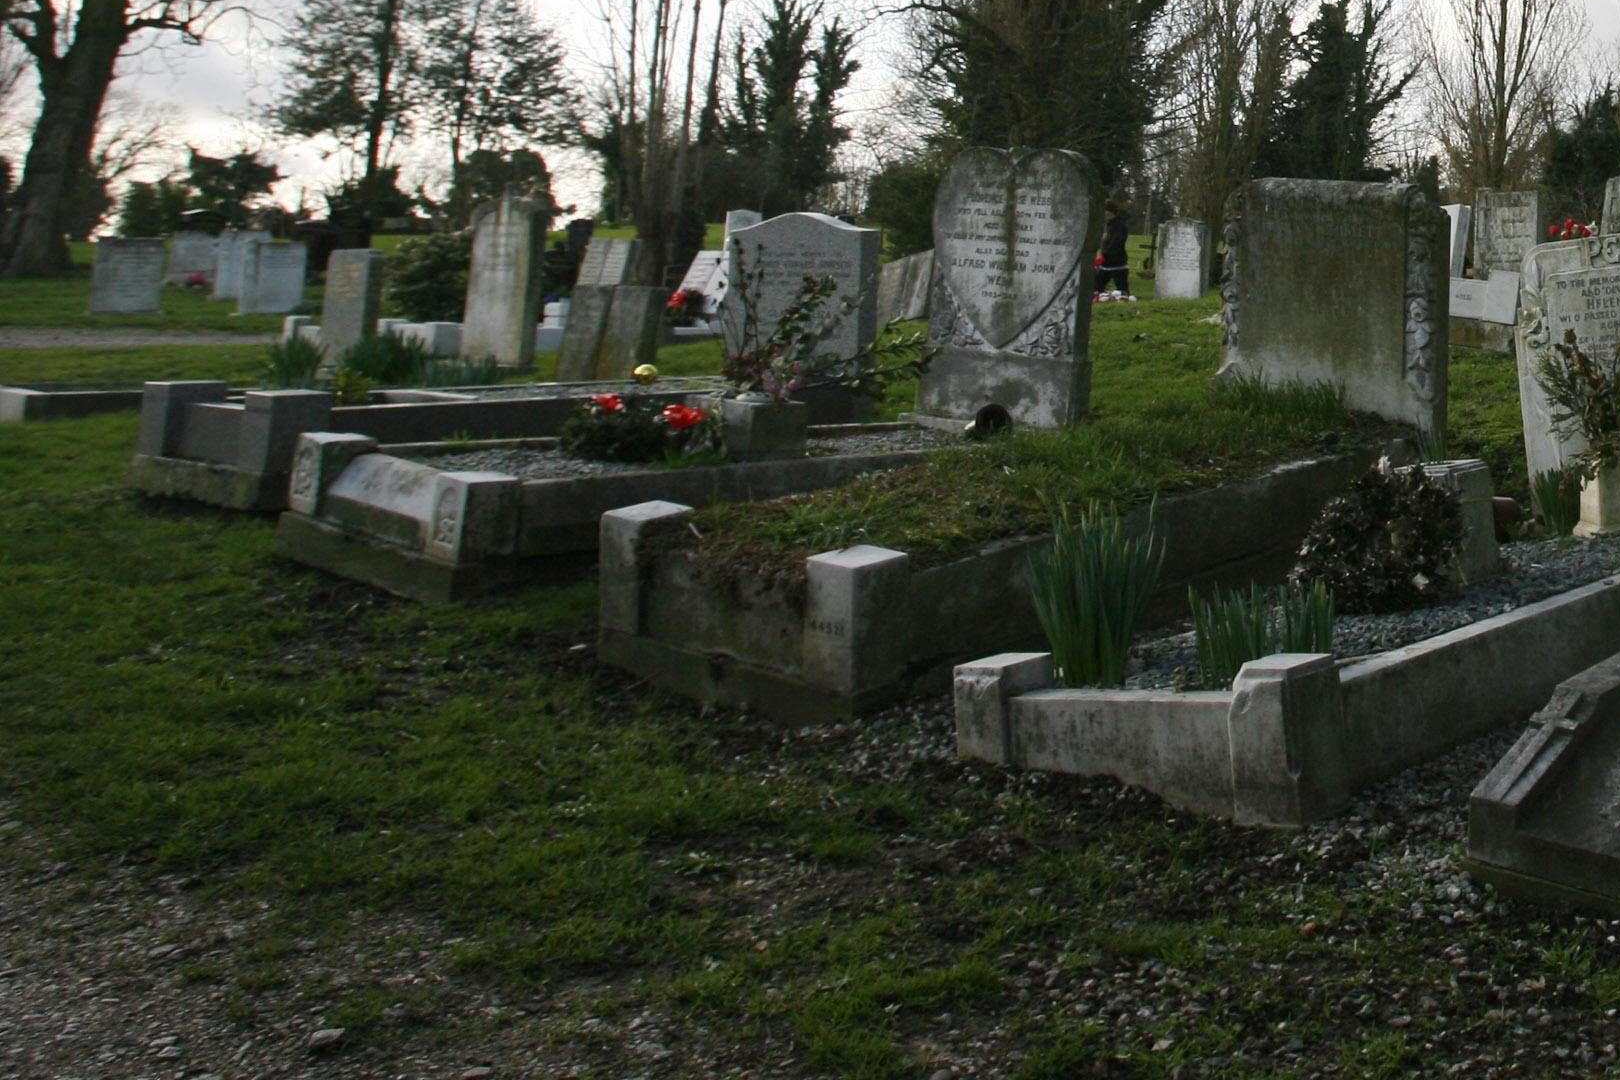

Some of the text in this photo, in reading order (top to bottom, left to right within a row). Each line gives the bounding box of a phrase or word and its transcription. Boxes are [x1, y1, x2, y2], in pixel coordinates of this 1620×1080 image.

[1031, 264, 1056, 274] JOHN
[1556, 281, 1567, 289] TO
[1571, 279, 1585, 288] THE
[1584, 309, 1617, 322] PASSED
